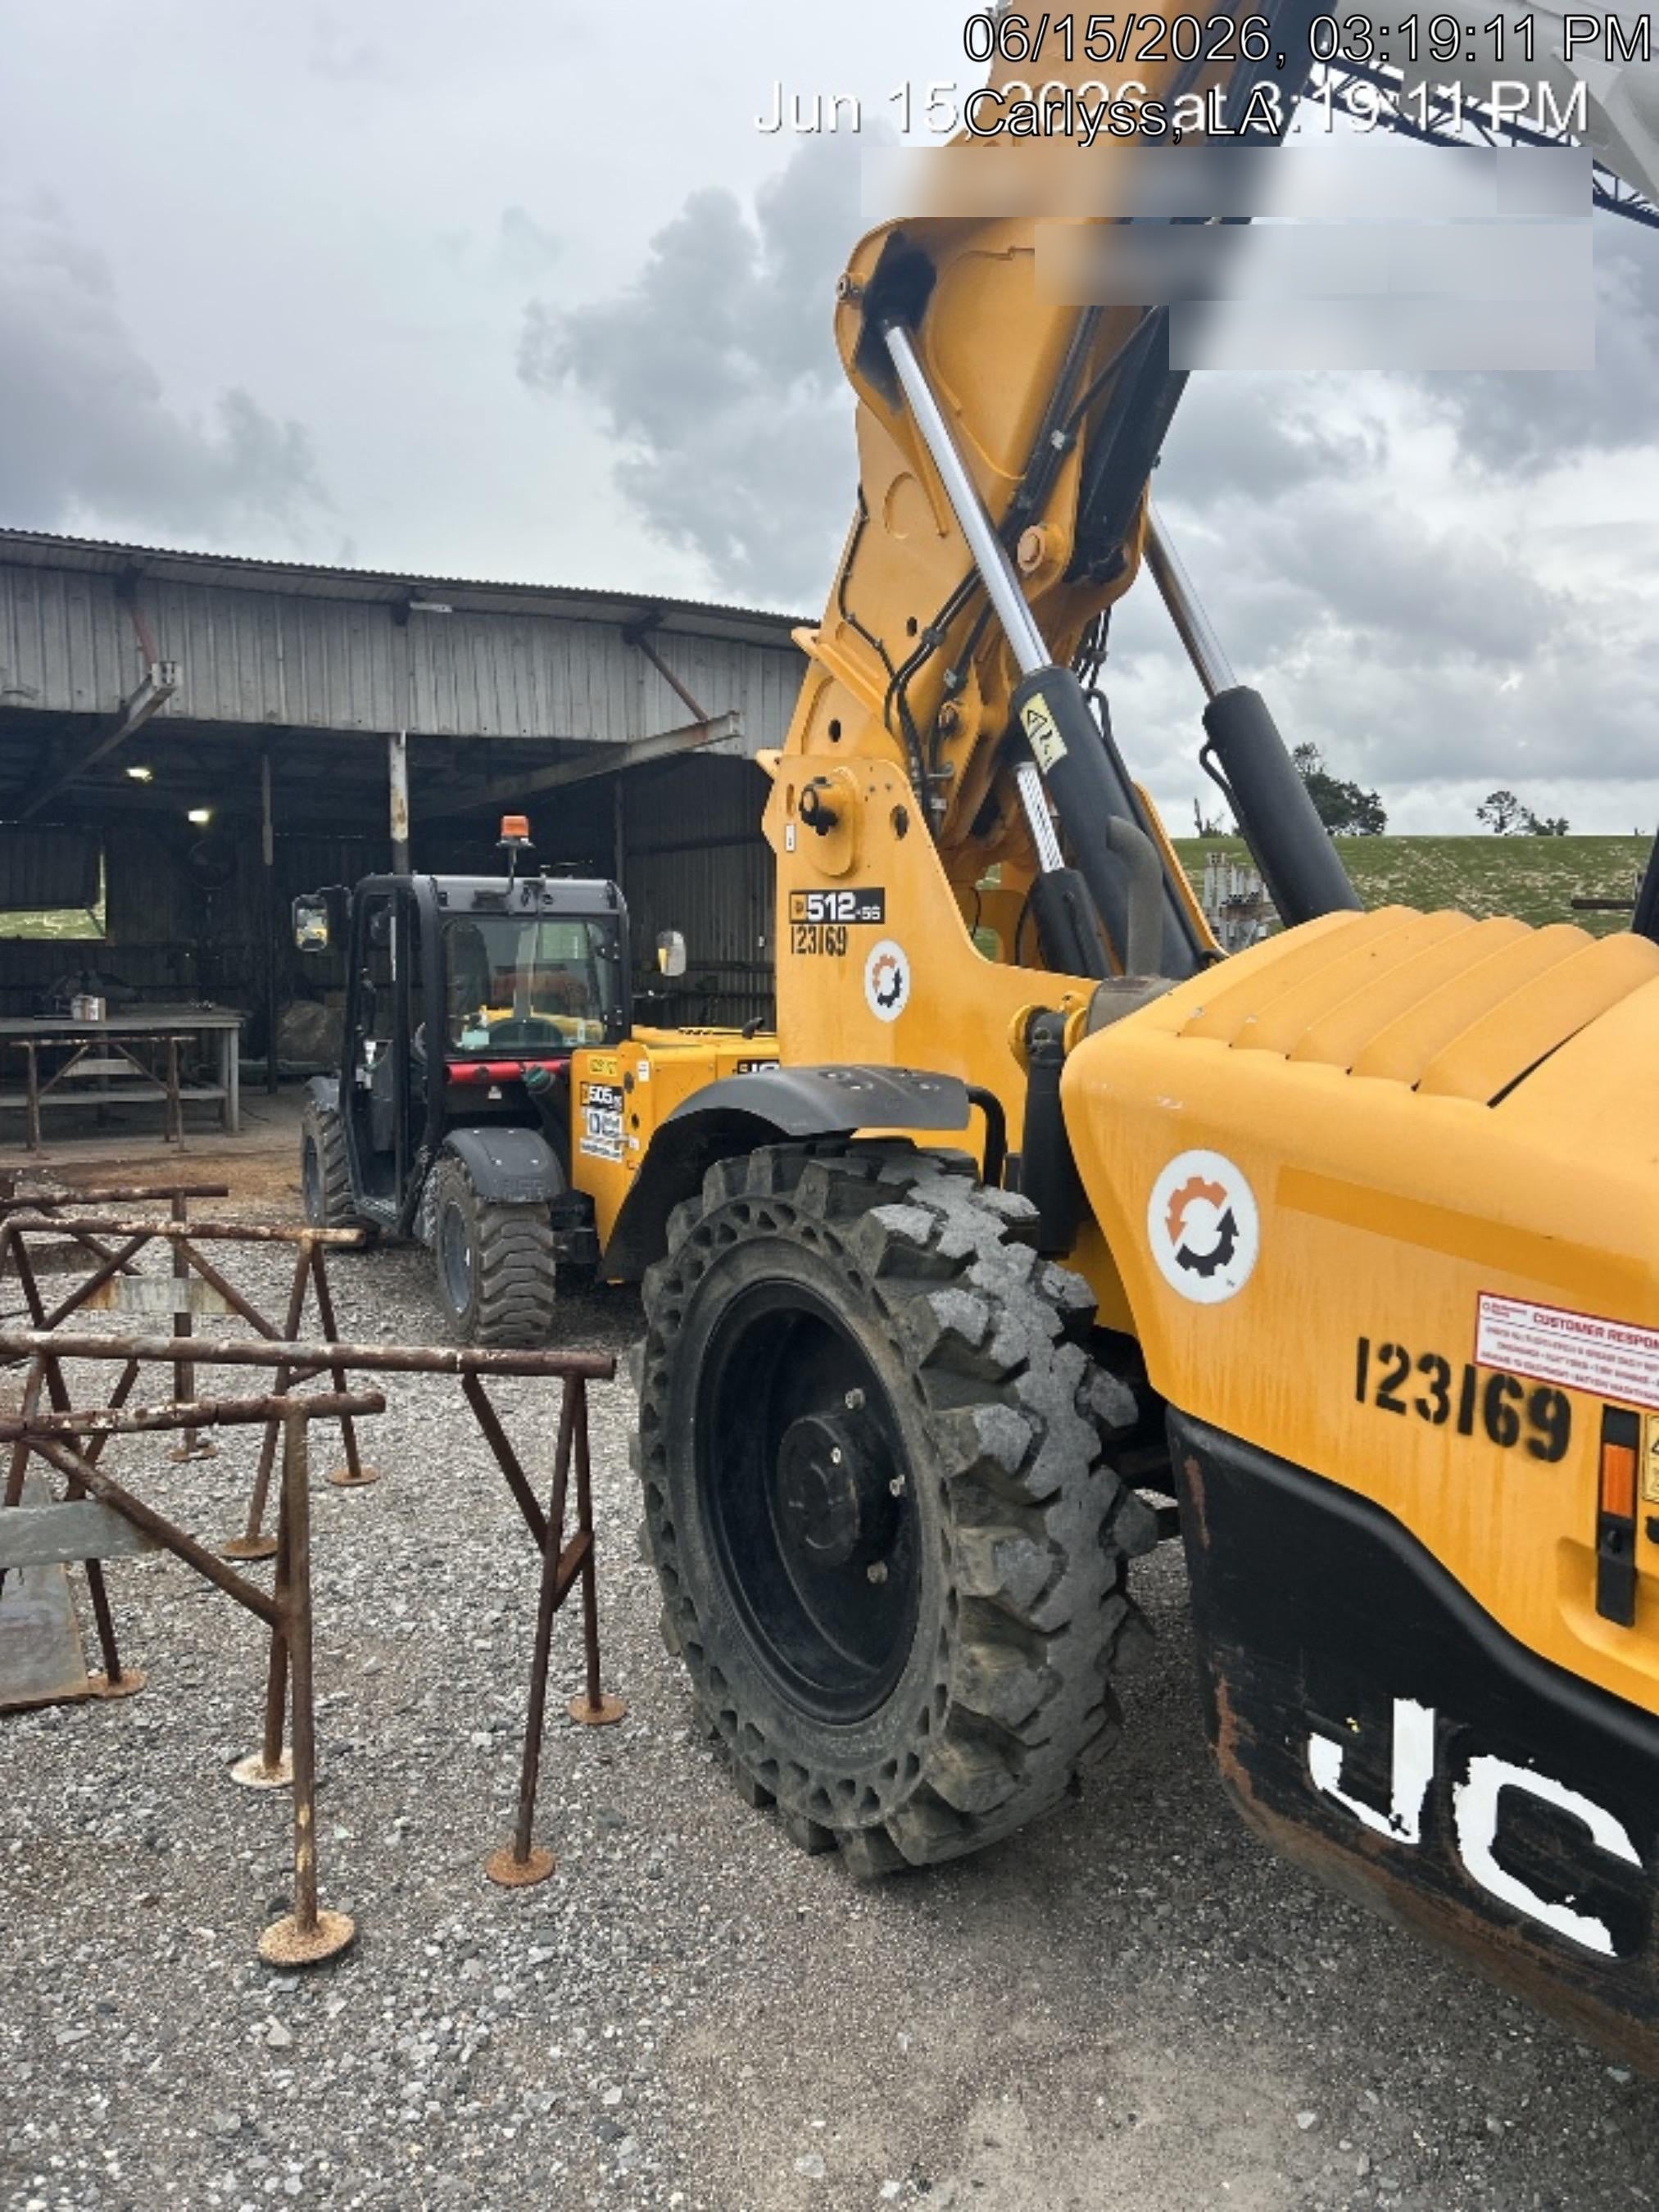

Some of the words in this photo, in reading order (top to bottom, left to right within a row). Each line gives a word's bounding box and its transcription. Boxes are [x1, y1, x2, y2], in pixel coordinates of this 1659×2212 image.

[791, 926, 847, 956] 123169
[1533, 1312, 1605, 1338] CUSTOMER
[1356, 1336, 1572, 1463] 123169
